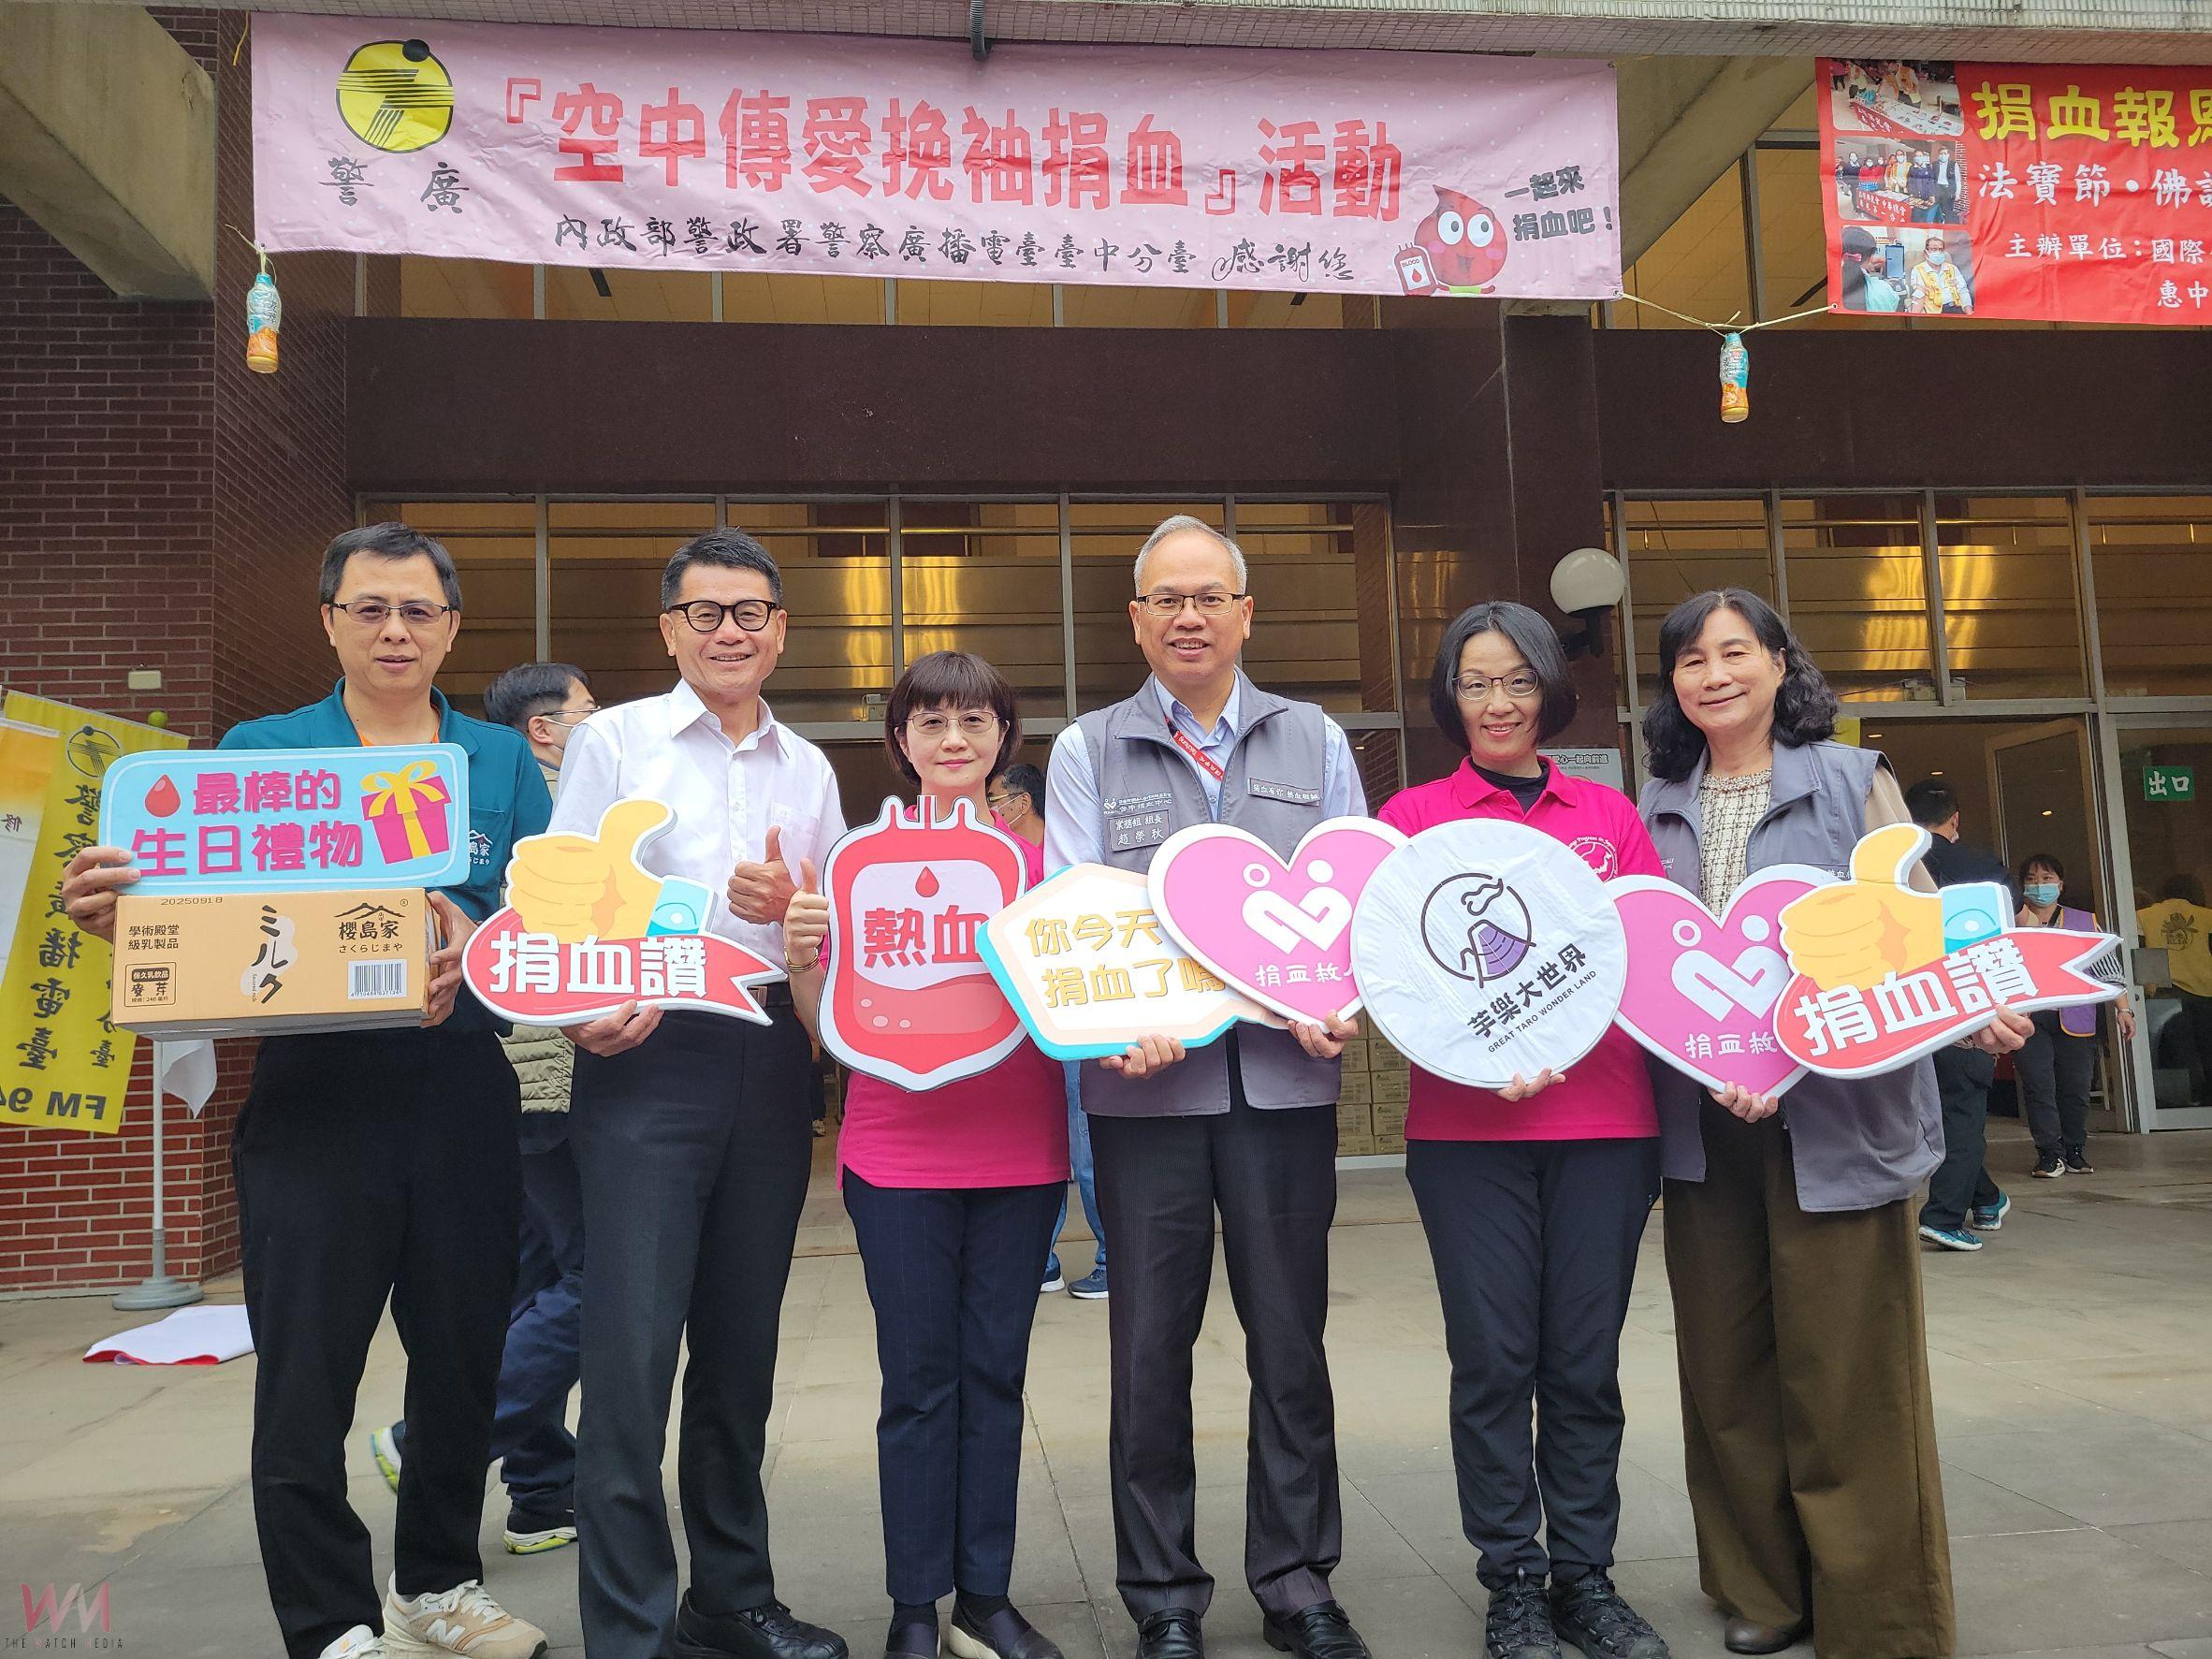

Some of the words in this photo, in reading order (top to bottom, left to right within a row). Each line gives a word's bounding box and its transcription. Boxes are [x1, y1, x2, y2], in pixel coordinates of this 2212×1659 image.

[505, 78, 1403, 222] 『空中傳愛挽袖捐血』活動
[1505, 166, 1585, 201] 一起來
[2004, 232, 2212, 265] 主辦單位：國際
[2157, 279, 2209, 309] 惠中
[193, 769, 342, 815] 最棒的
[2148, 770, 2190, 795] 出口
[1144, 814, 1164, 825] 組長
[131, 820, 365, 877] 生日禮物
[160, 896, 224, 906] 20250918
[127, 938, 179, 951] 級乳製品
[128, 924, 180, 937] 學術殿堂
[339, 920, 400, 940] 櫻島家
[339, 942, 403, 953] さくらじまや
[864, 905, 990, 968] 熱血
[1025, 909, 1163, 957] 你今天
[250, 904, 289, 1004] ミルク
[489, 930, 707, 998] 捐血讚
[1041, 958, 1226, 1008] 捐血了嗎
[1255, 962, 1353, 988] 捐血救
[1467, 943, 1586, 1039] 芋樂大世界
[1488, 1030, 1516, 1053] GREAT
[1516, 1014, 1538, 1033] TARO
[1538, 987, 1574, 1016] WONDER
[1574, 970, 1596, 990] LAND
[1794, 938, 2040, 1056] 捐血讚
